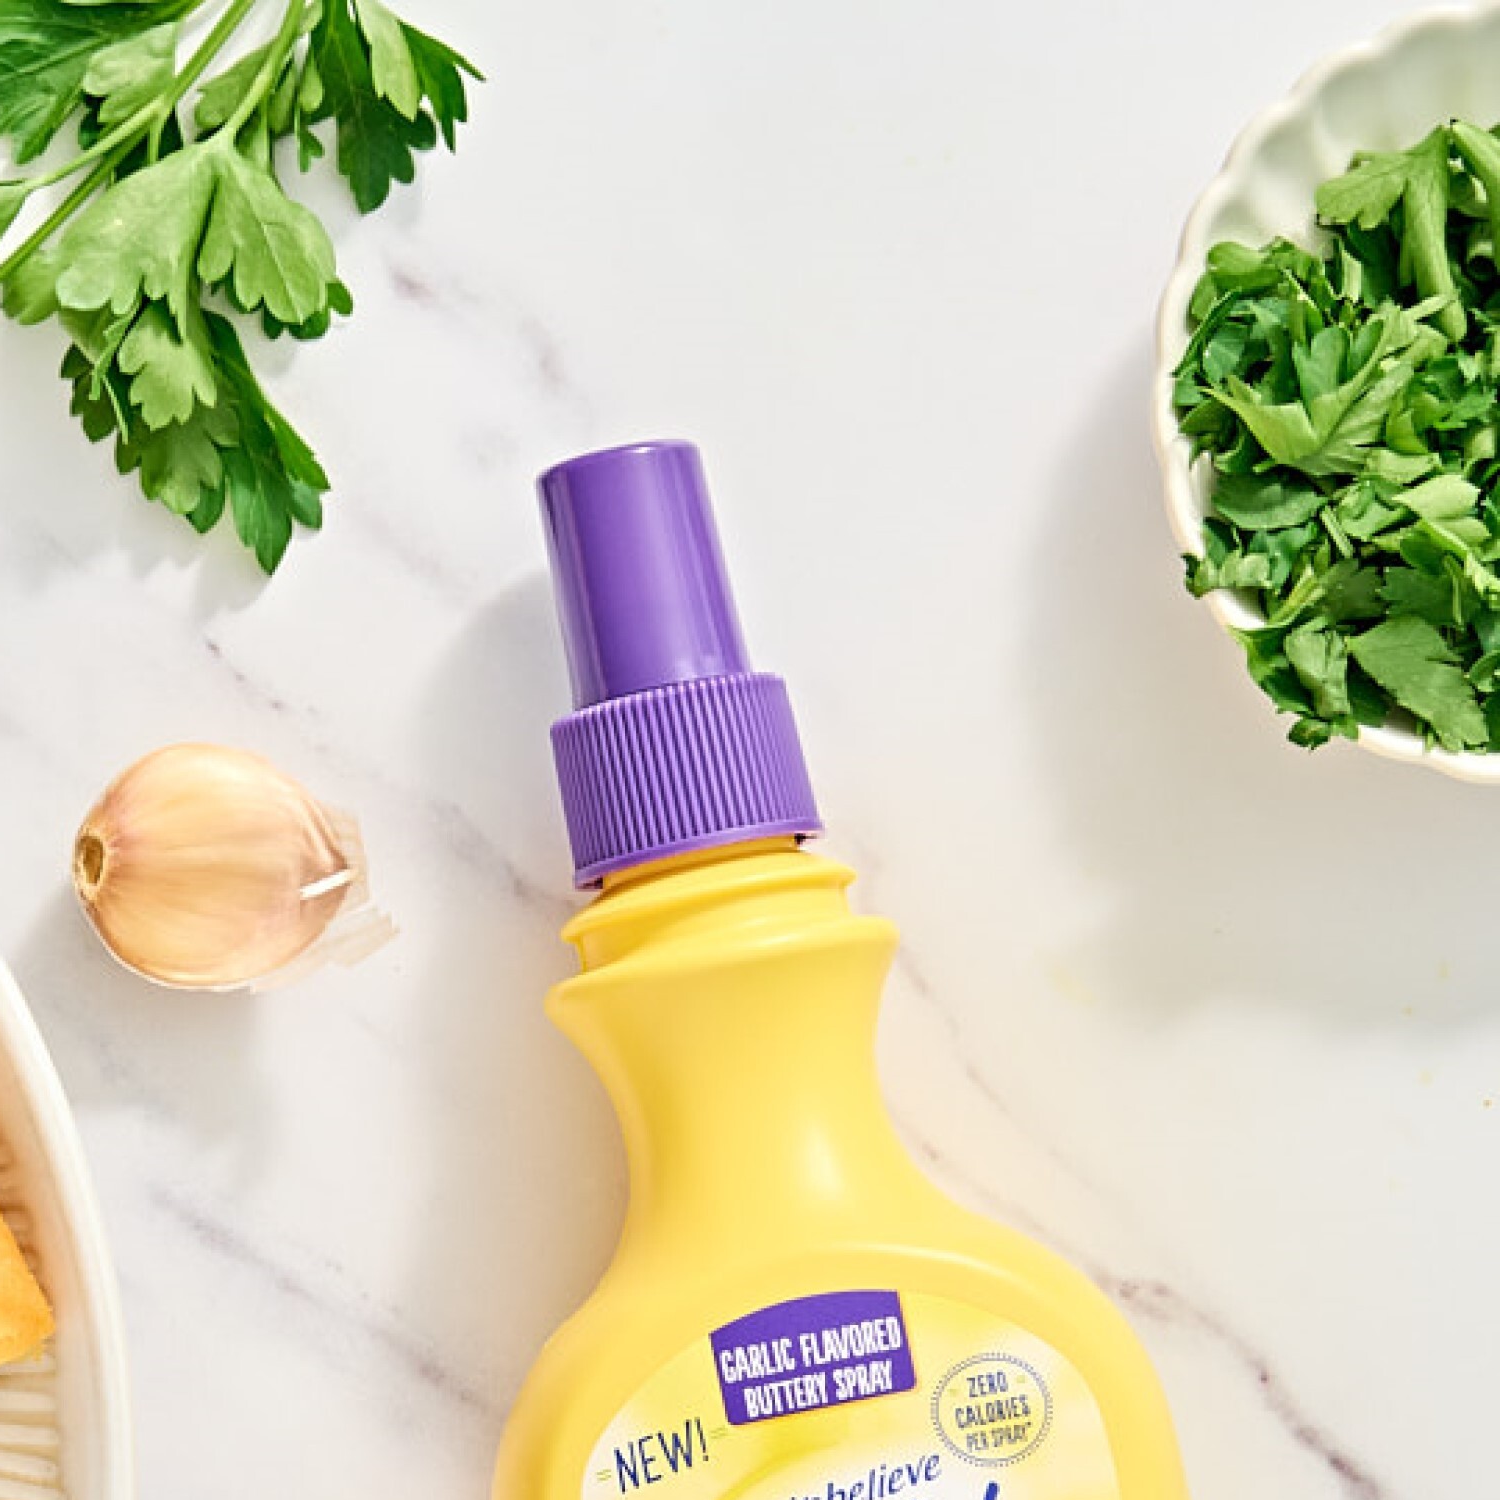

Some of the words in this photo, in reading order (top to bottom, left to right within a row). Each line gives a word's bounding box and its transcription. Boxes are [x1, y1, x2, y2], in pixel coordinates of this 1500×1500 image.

[720, 1339, 795, 1384] GARLIC
[800, 1316, 900, 1367] FLAVORED
[744, 1371, 828, 1418] BUTTERY
[833, 1361, 893, 1400] SPRAY
[966, 1369, 1008, 1397] ZERO
[955, 1394, 1030, 1430] CALORIES
[613, 1417, 709, 1495] NEW!
